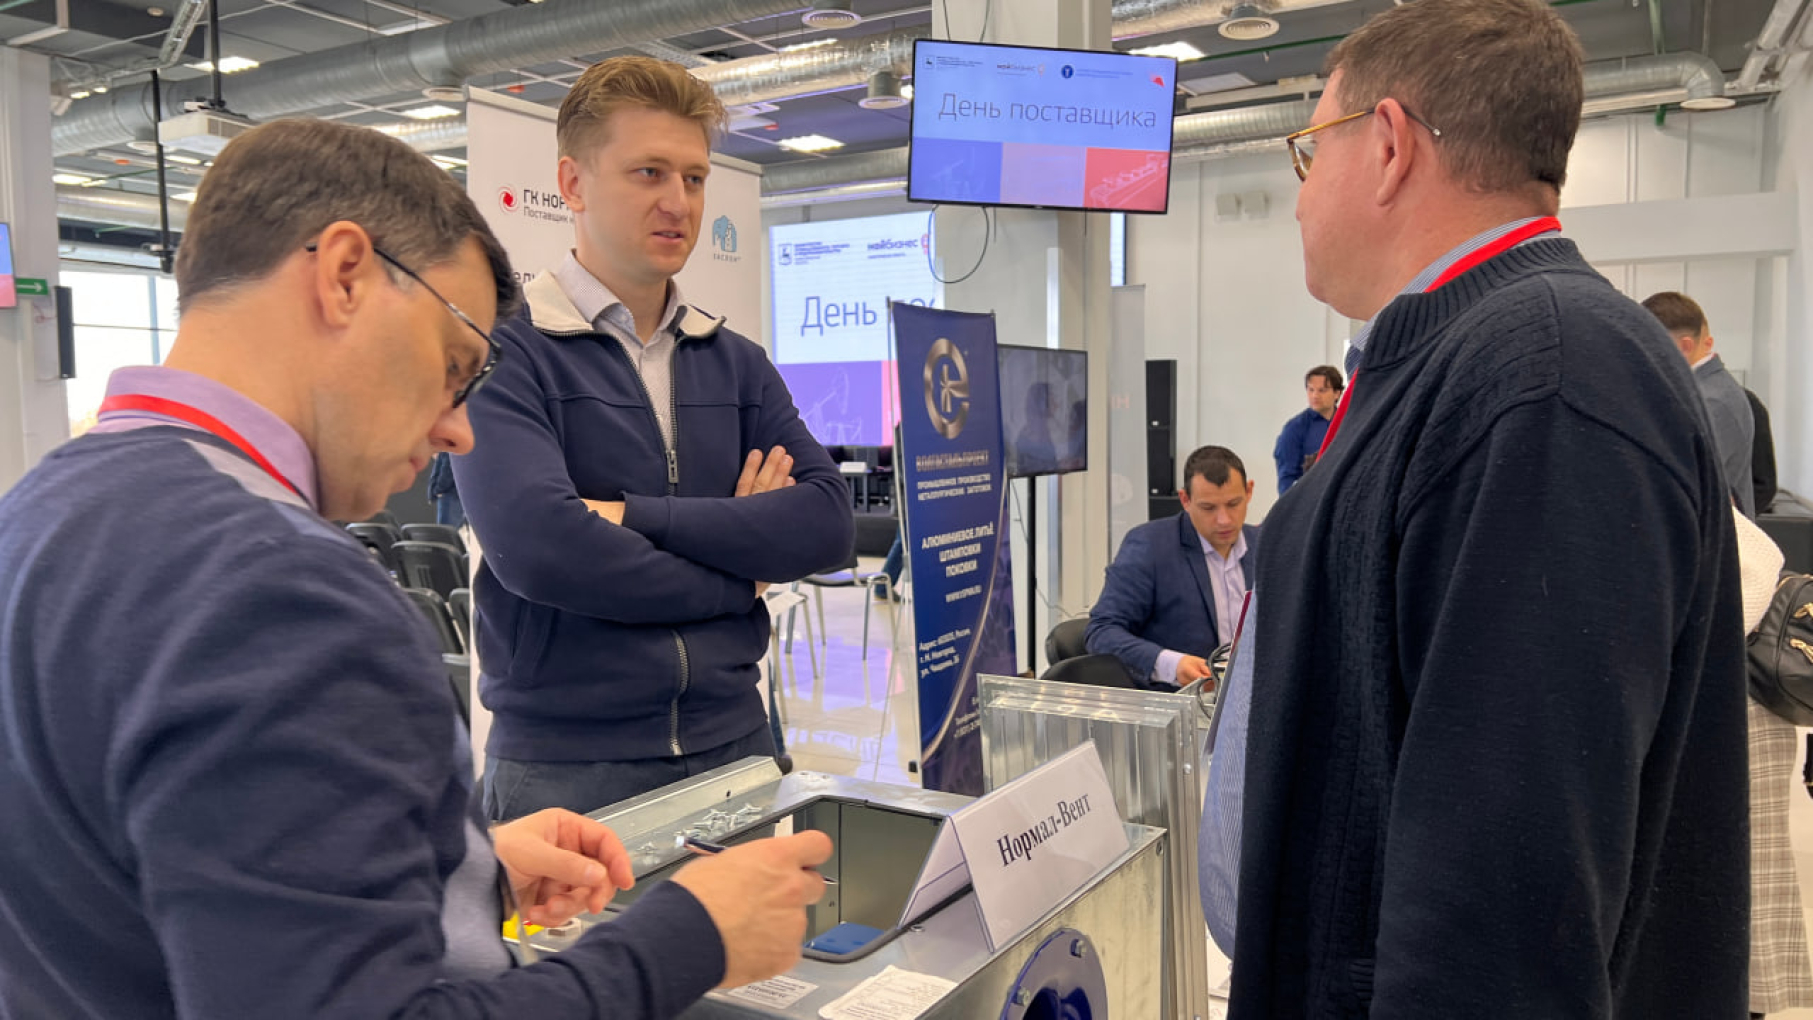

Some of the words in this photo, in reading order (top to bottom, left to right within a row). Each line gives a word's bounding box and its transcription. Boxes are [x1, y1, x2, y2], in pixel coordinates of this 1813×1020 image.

[938, 92, 1001, 122] День
[1009, 102, 1157, 129] поставщика
[523, 189, 539, 206] ГК
[542, 192, 570, 210] НОР
[523, 206, 569, 224] Поставщик
[801, 295, 878, 337] День
[996, 794, 1092, 867] Нормал-Вент
